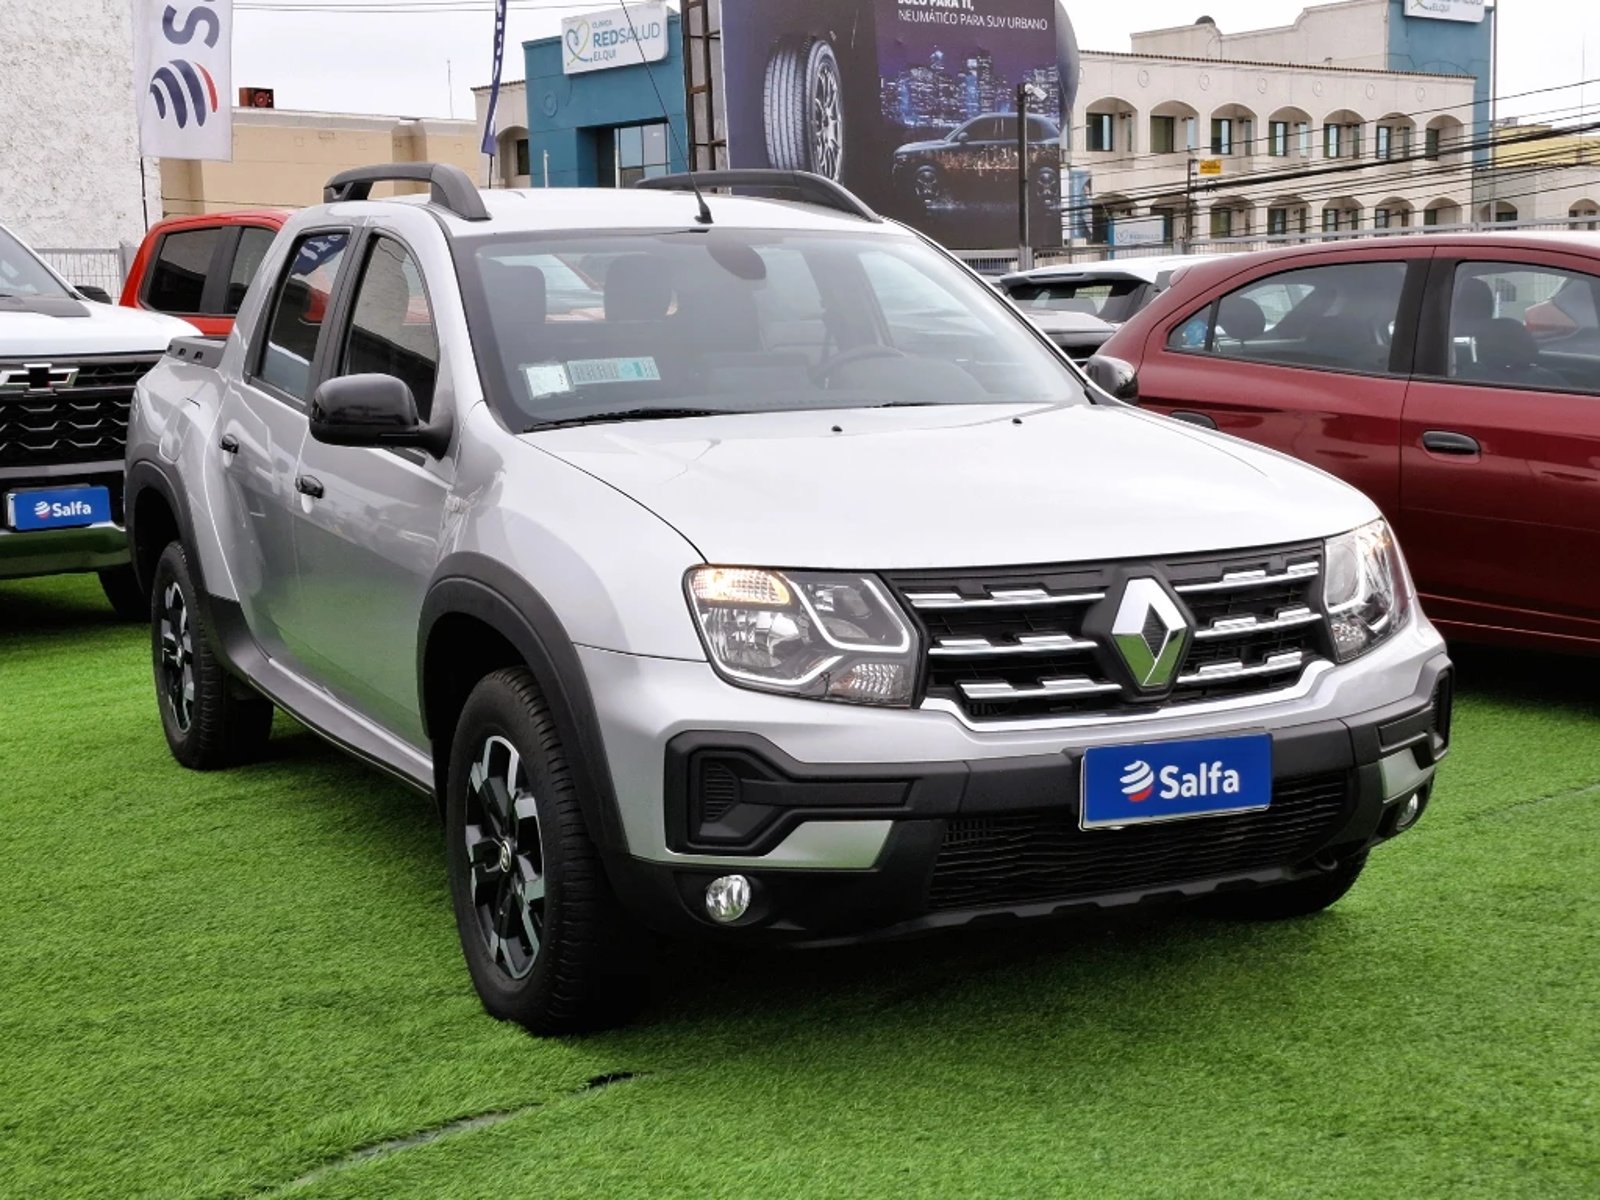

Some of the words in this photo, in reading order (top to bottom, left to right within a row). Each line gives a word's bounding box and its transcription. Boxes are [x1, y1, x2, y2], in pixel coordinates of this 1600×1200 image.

[898, 9, 958, 25] NEUMÁTICO
[960, 13, 985, 26] PARA
[987, 15, 1006, 28] SUV
[1007, 16, 1048, 31] URBANO
[593, 22, 660, 48] REDSALUD
[593, 49, 616, 61] ELQUI
[52, 501, 92, 517] Salfa
[1159, 760, 1240, 799] Salfa
